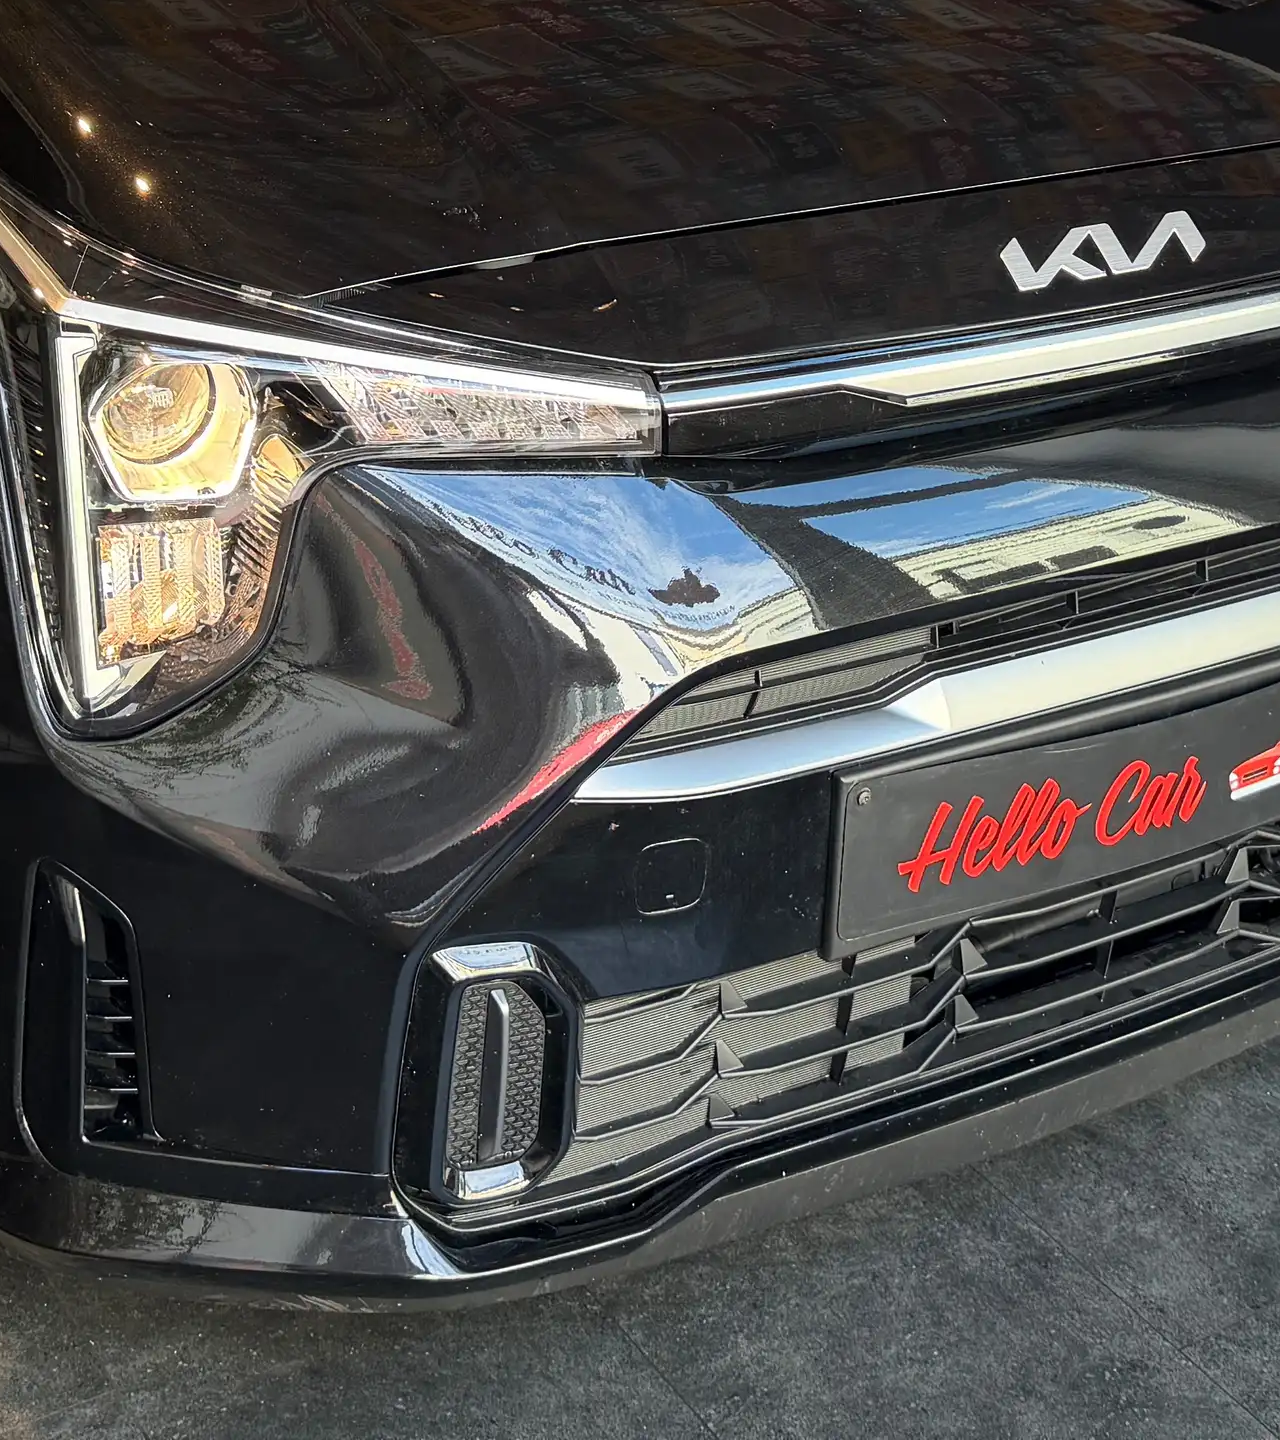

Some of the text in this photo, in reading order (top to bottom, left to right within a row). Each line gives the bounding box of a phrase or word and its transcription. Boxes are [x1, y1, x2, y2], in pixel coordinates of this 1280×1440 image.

[999, 210, 1207, 292] KIA
[897, 755, 1208, 893] Hello Car
